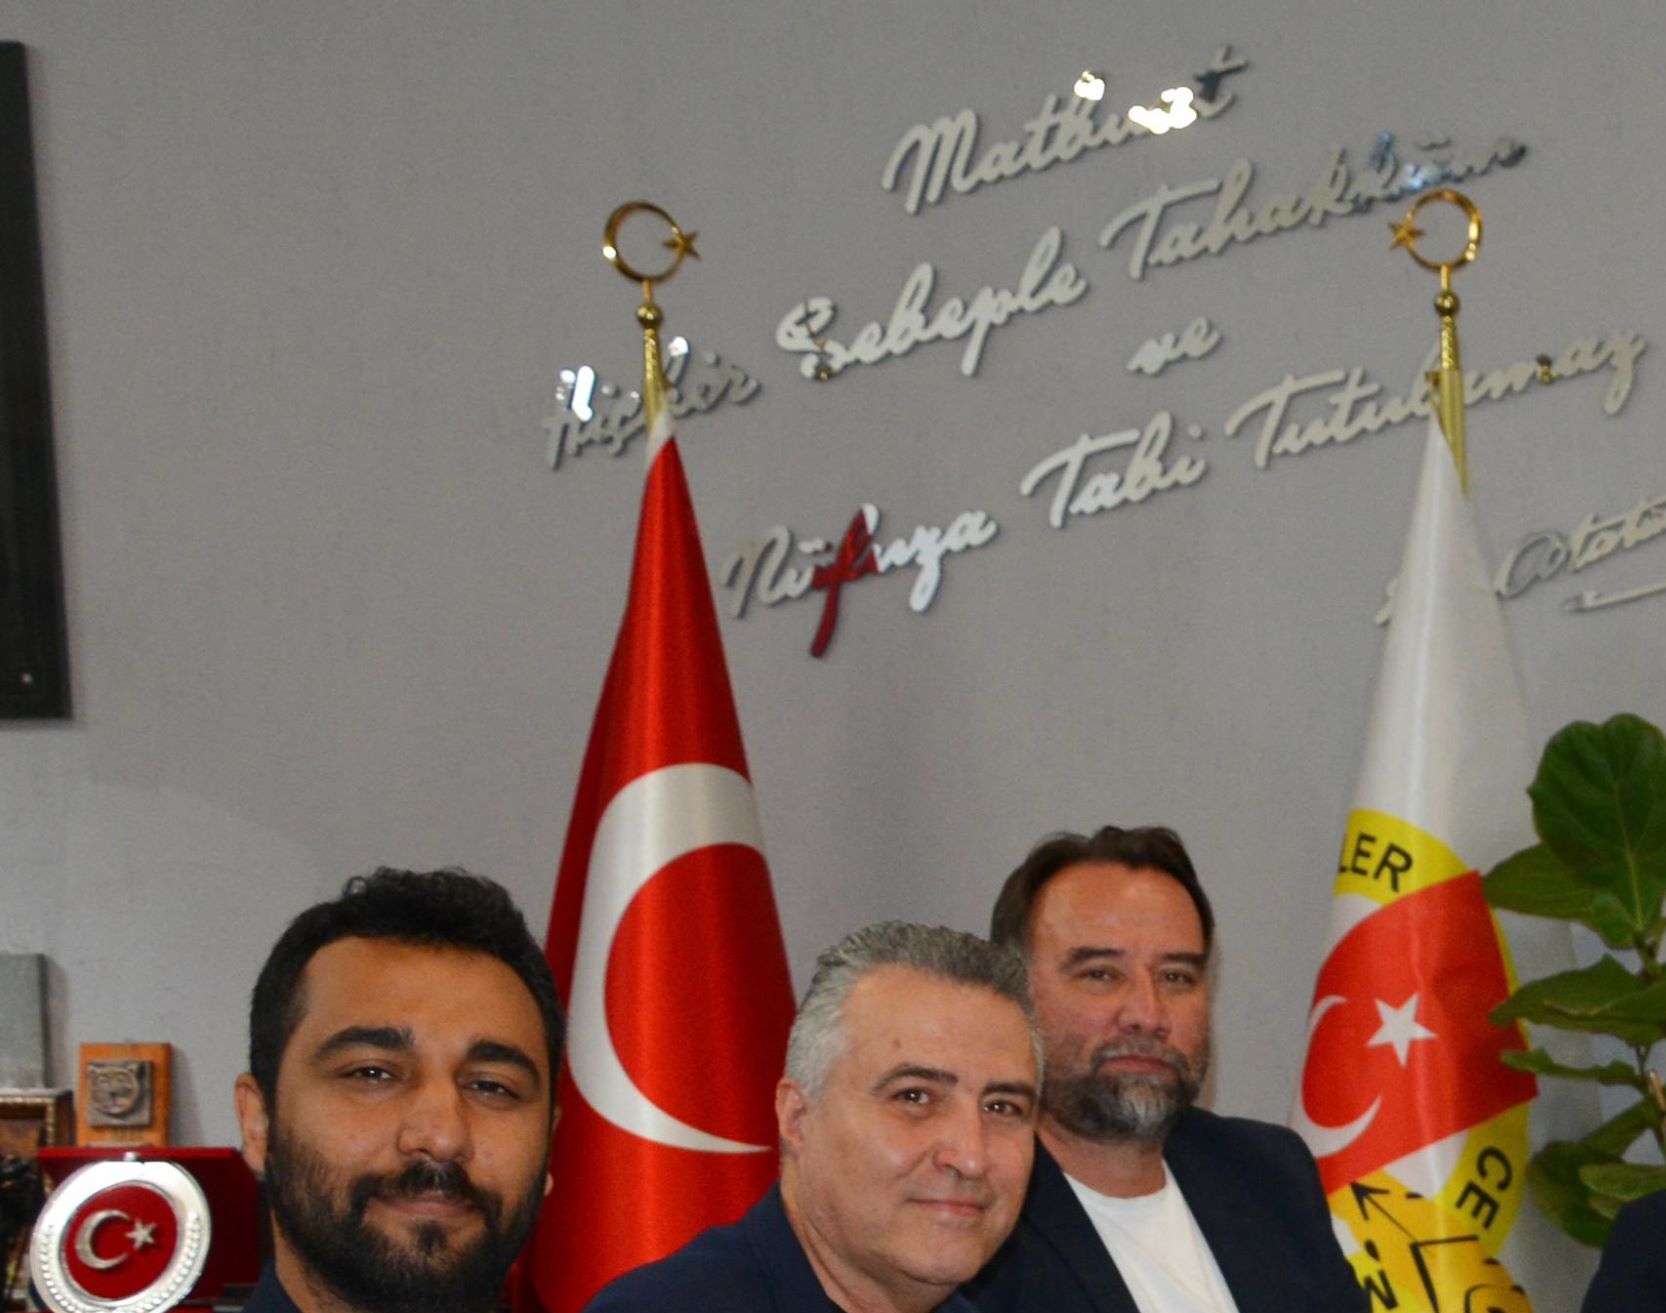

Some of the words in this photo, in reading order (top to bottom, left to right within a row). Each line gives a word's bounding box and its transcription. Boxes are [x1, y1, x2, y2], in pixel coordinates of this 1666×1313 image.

[776, 230, 1087, 380] Sebeple
[1126, 317, 1221, 376] ve
[1020, 411, 1207, 530] Tabi
